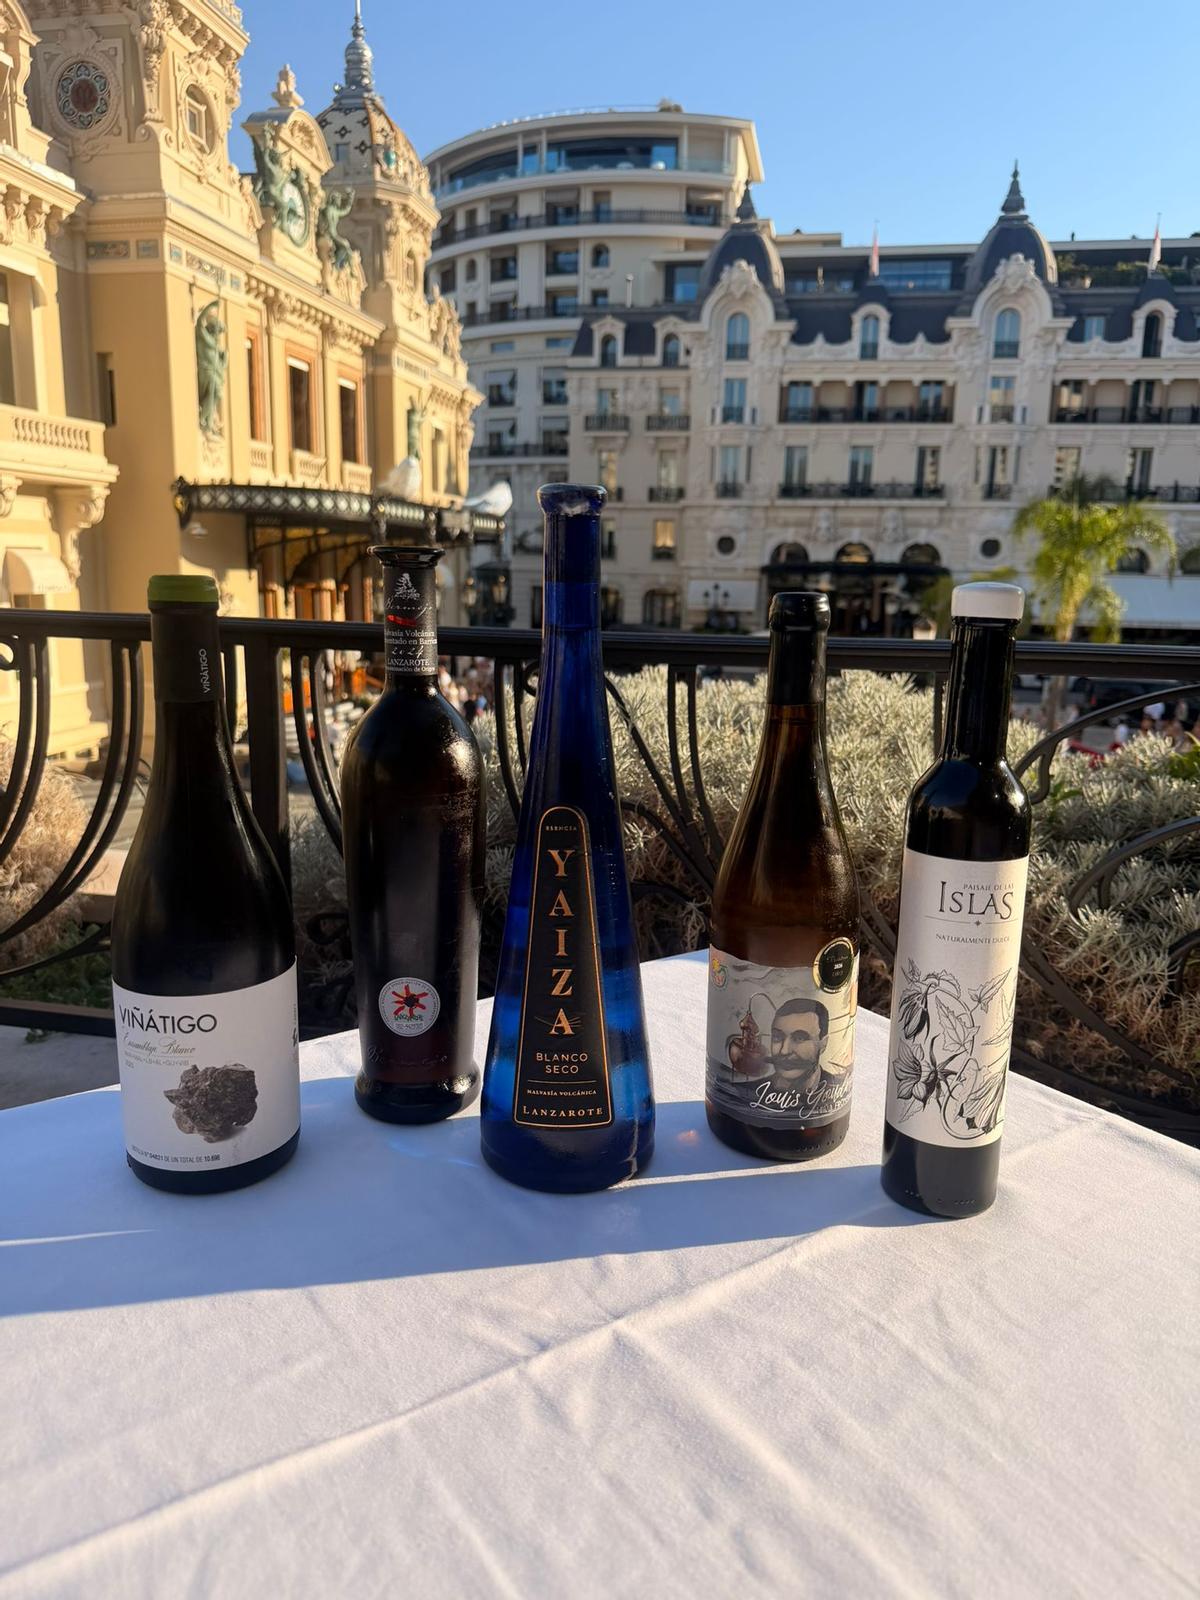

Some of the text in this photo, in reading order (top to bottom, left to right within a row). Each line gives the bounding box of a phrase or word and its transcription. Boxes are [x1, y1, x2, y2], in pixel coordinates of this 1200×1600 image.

[387, 658, 430, 667] LANZAROTE
[198, 648, 211, 693] VIÑÁTIGO
[938, 880, 1014, 920] ISLAS
[547, 849, 576, 1036] YAIZA
[935, 933, 991, 945] NATURALMENTE
[118, 1004, 218, 1034] VIÑÁTIGO
[536, 1052, 588, 1062] BLANCO
[545, 1064, 579, 1074] SECO
[526, 1088, 597, 1097] MALVASÍA VOLCÁNICA
[749, 1081, 800, 1113] Louis
[522, 1105, 603, 1118] LANZAROTE
